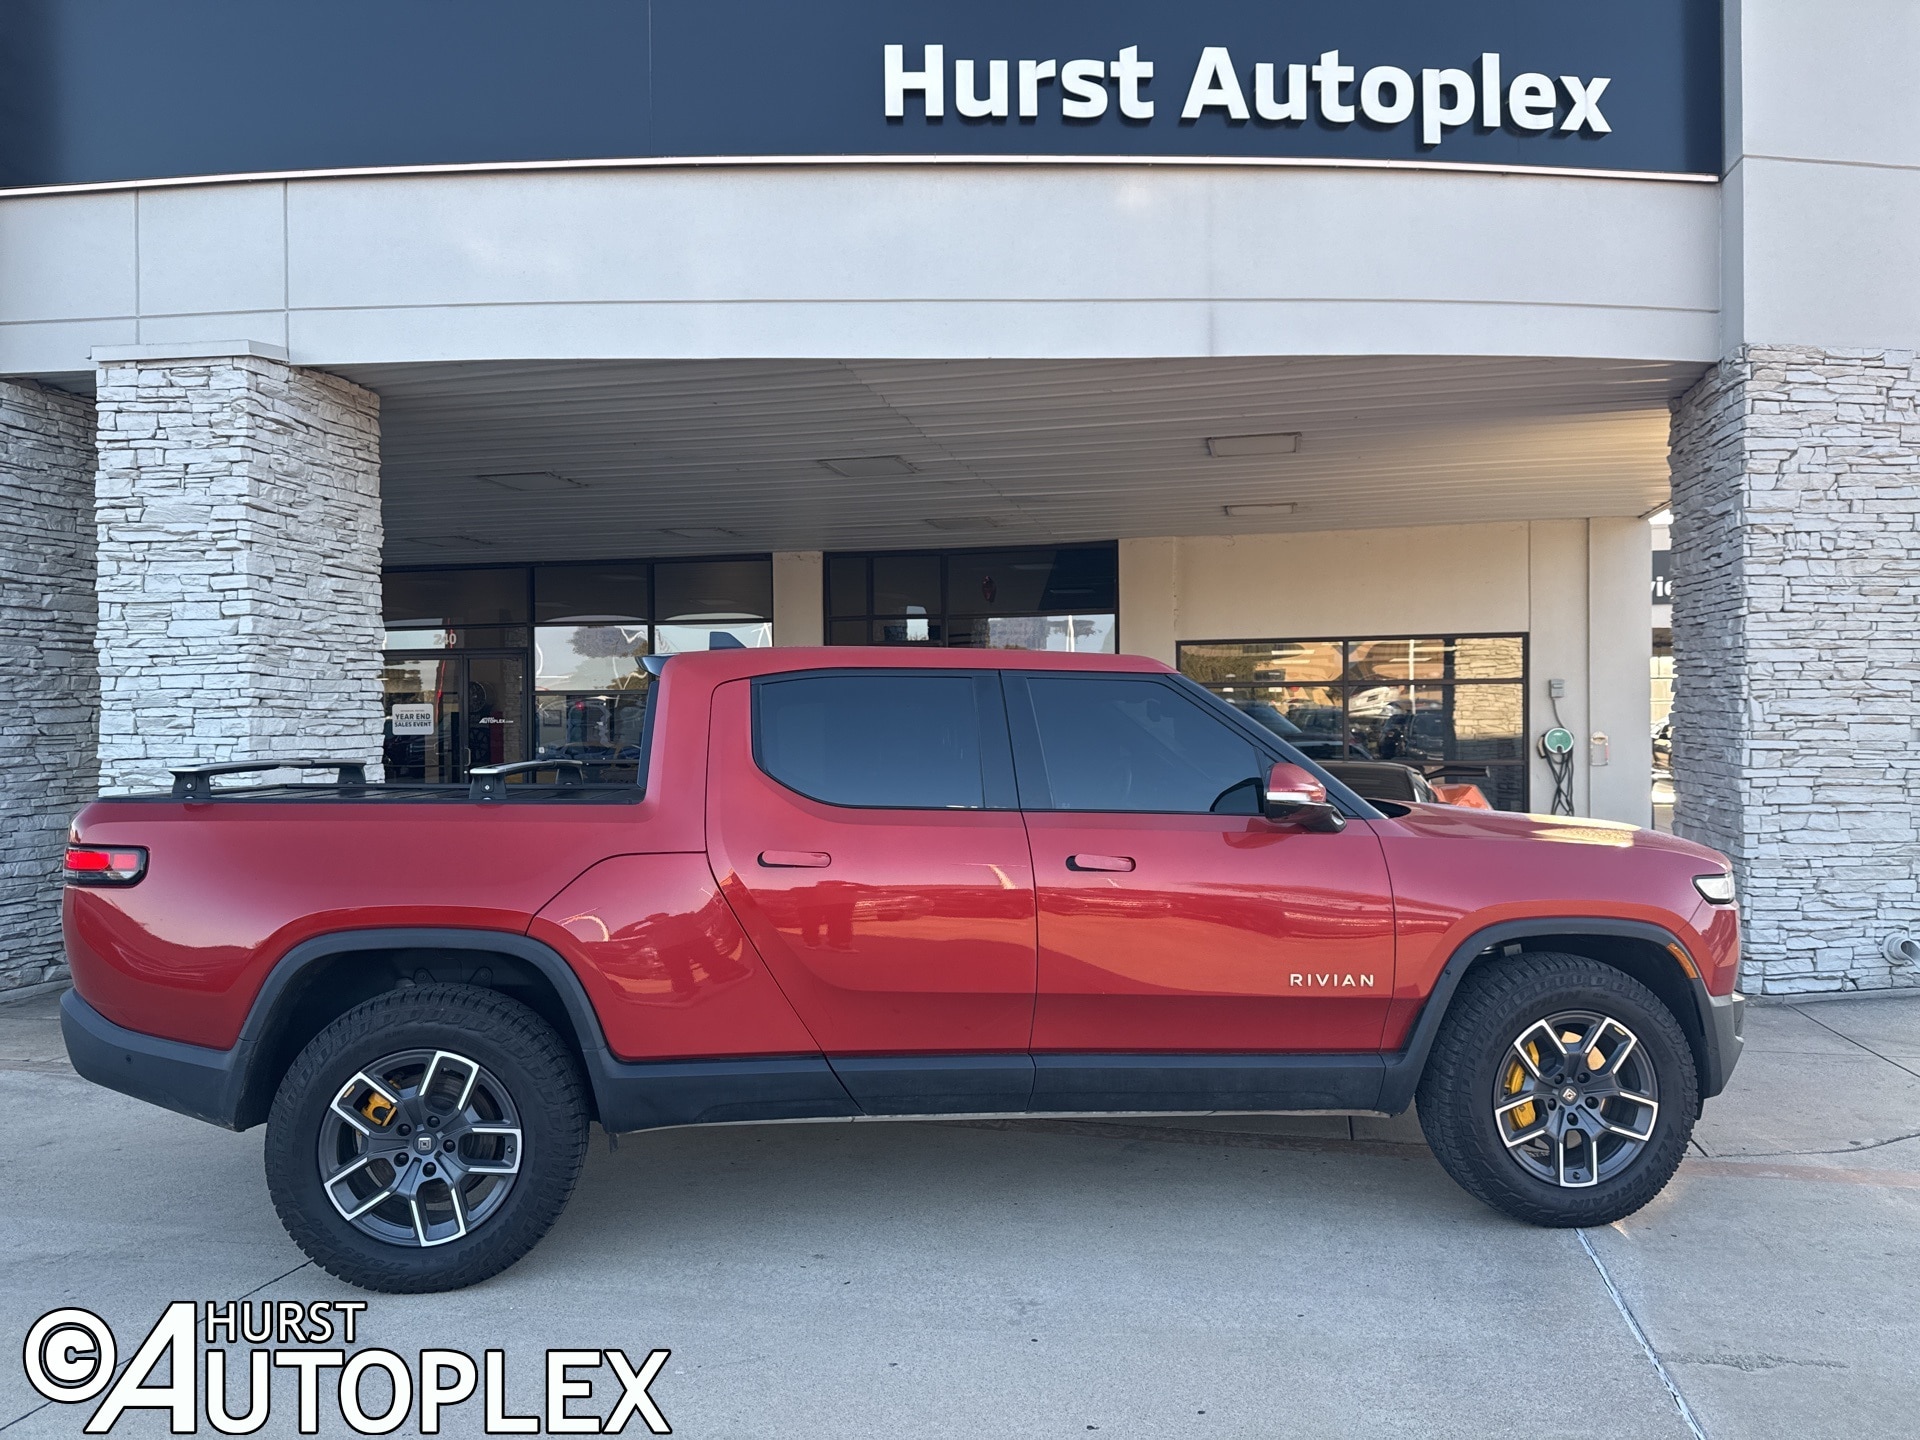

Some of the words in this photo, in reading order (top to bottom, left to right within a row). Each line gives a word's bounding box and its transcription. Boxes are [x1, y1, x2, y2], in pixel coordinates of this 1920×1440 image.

[884, 45, 1155, 120] Hurst
[1181, 46, 1611, 145] Autoplex
[433, 633, 457, 645] 240
[1290, 973, 1374, 987] RIVIAN
